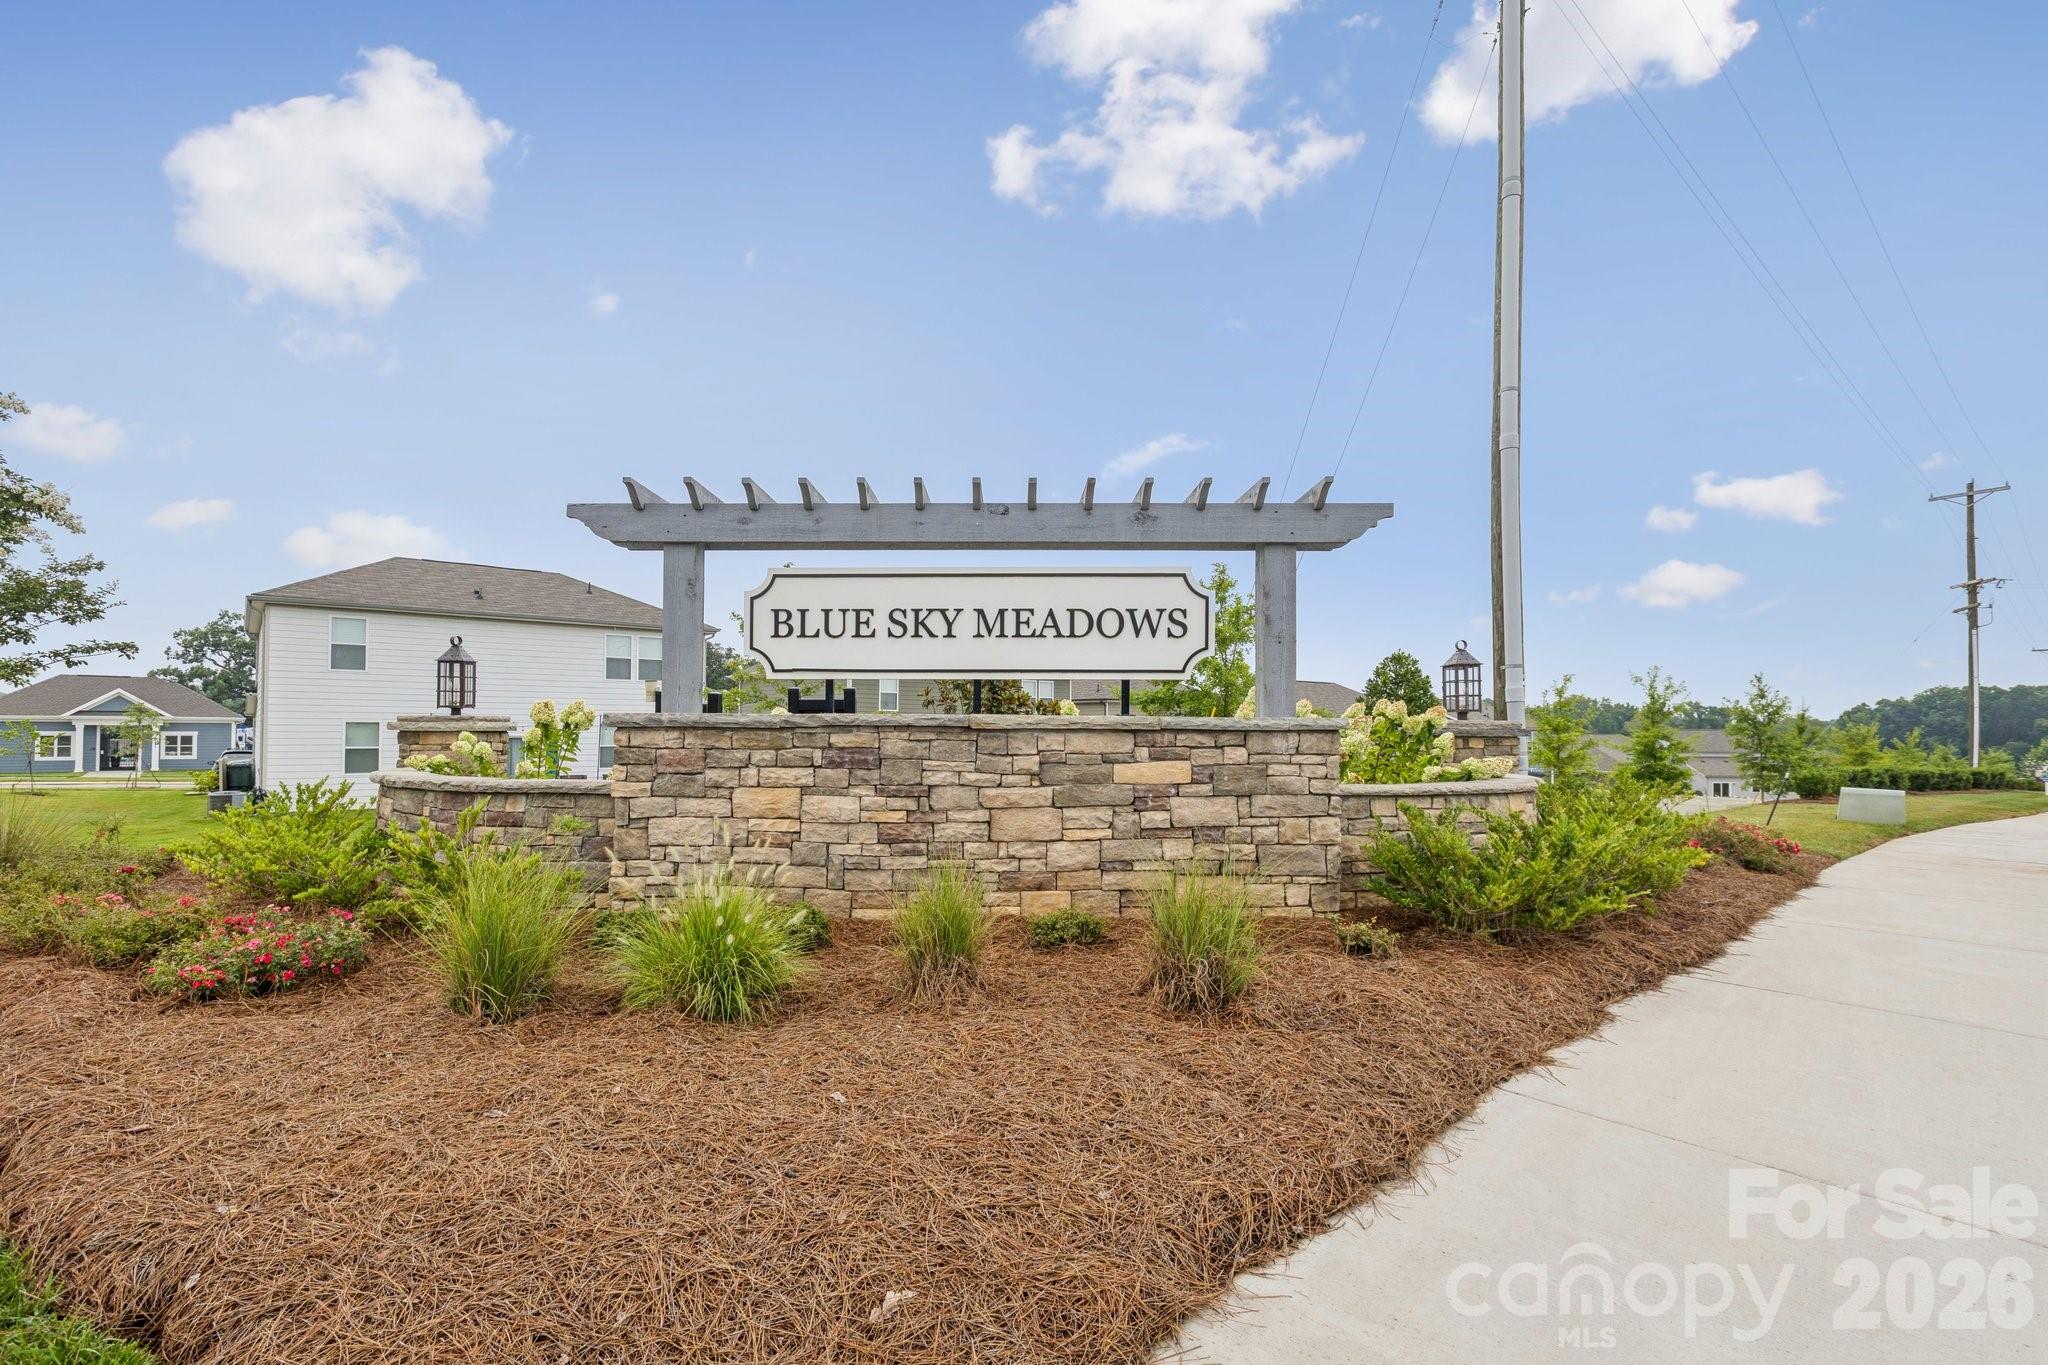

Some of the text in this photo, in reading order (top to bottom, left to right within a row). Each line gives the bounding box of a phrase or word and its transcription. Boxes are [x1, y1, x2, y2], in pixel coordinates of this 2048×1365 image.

[770, 607, 1189, 639] BLUE SKY MEADOWS
